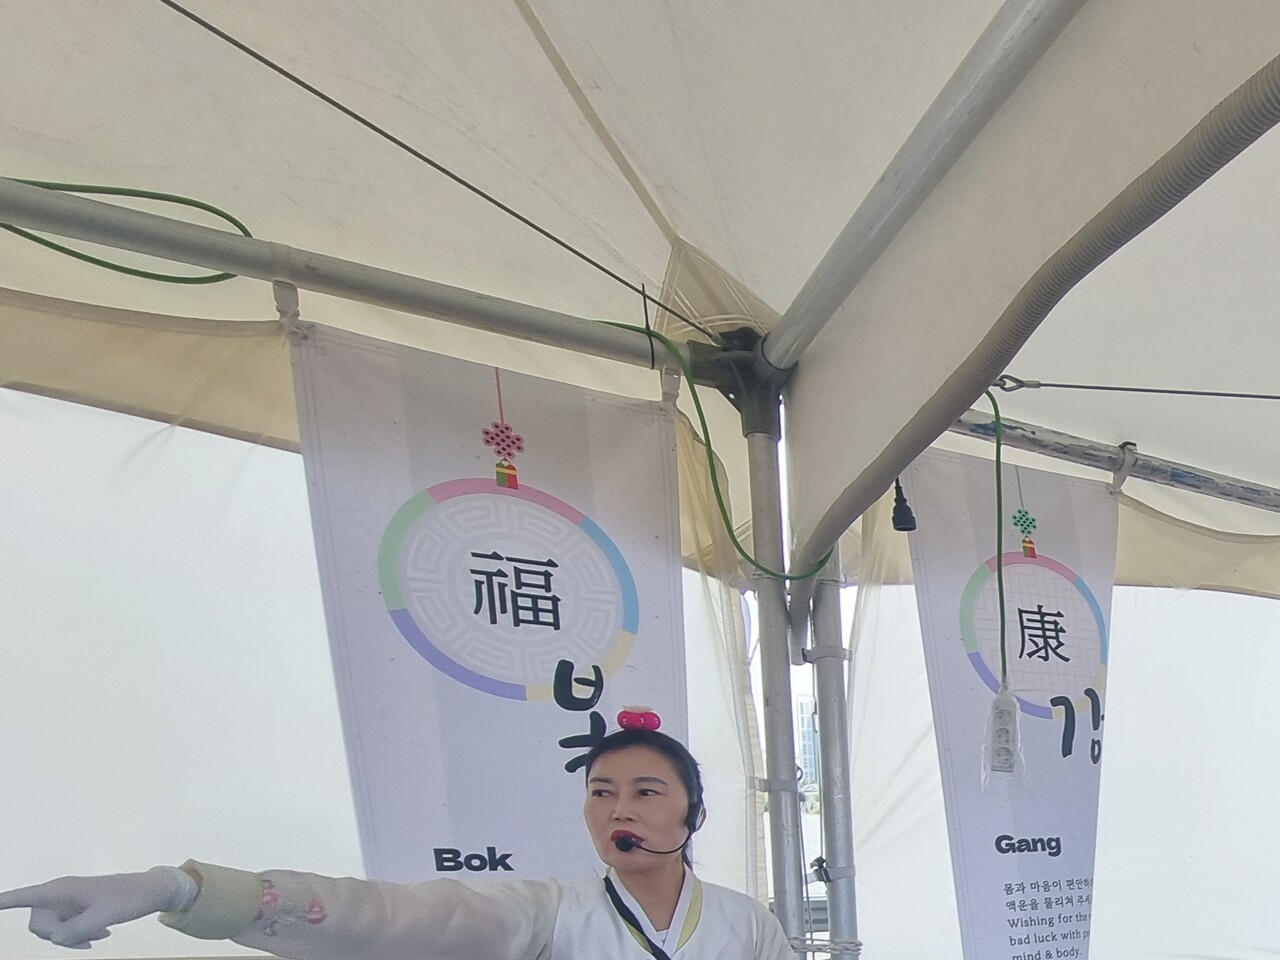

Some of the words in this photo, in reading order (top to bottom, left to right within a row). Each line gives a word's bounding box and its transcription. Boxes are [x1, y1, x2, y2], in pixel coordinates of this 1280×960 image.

[469, 551, 562, 631] 福
[1017, 604, 1071, 663] 康
[995, 835, 1062, 857] Gang
[433, 846, 514, 872] Bok
[1004, 882, 1026, 896] 몸과
[1030, 879, 1062, 893] 마음이
[1006, 898, 1039, 912] 액운을
[1044, 895, 1074, 909] 물리쳐
[1007, 916, 1054, 928] Wishing
[1058, 912, 1073, 924] for
[1075, 911, 1088, 922] the
[1009, 934, 1031, 947] bad
[1034, 931, 1058, 943] luck
[1060, 929, 1081, 940] with
[1045, 949, 1053, 960] &
[1056, 945, 1081, 959] body.
